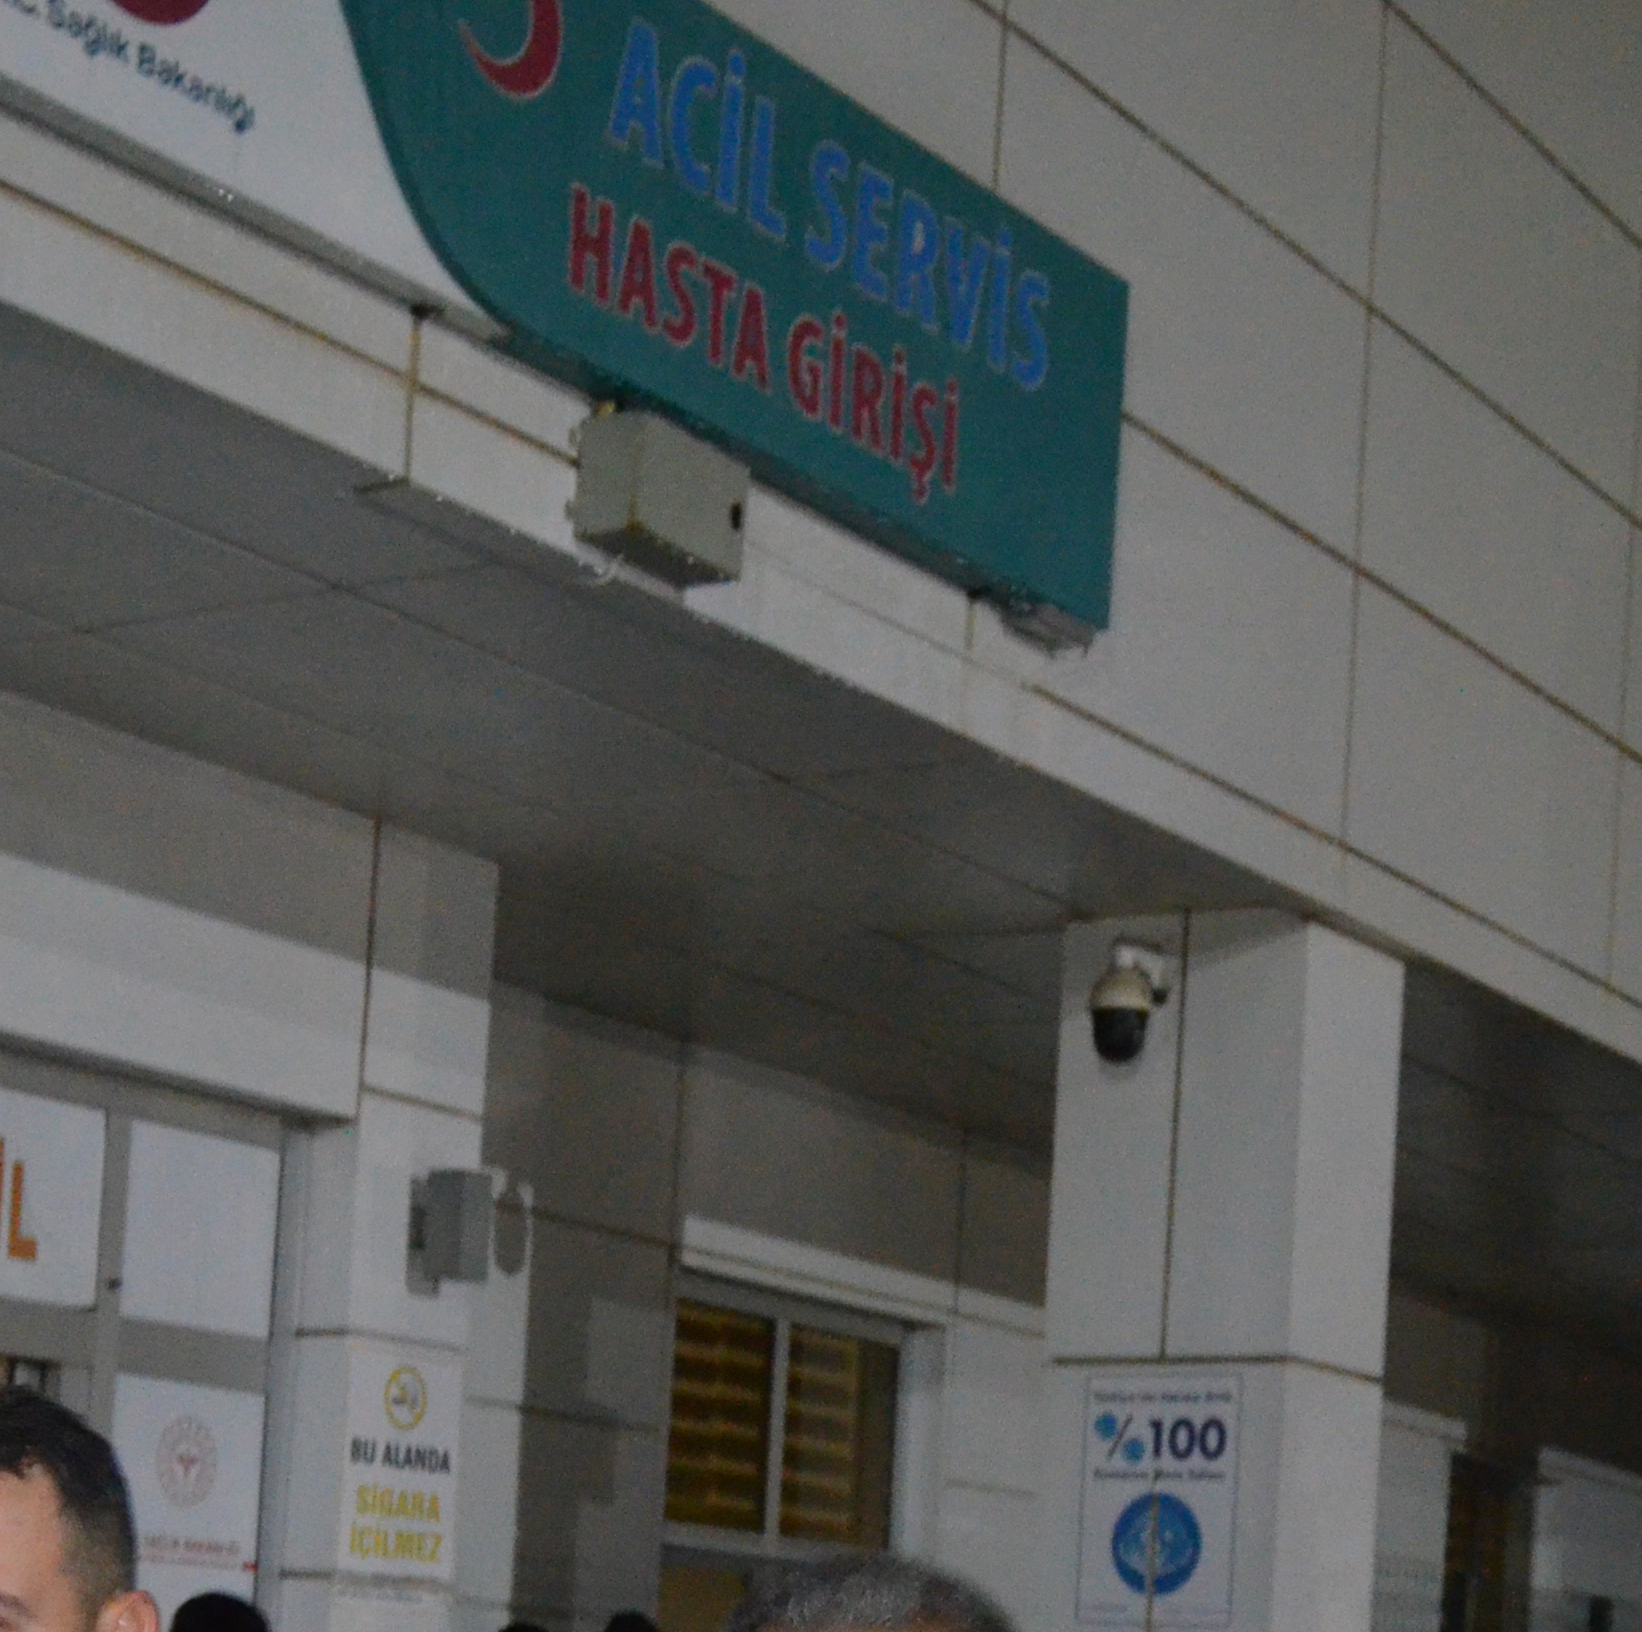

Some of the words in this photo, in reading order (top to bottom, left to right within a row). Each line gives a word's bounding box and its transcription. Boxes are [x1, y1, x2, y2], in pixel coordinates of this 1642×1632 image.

[567, 184, 772, 397] HASTA
[787, 309, 959, 505] GİRİŞİ
[609, 20, 787, 242] ACİL
[803, 138, 1049, 392] SERVİS
[350, 1436, 376, 1465] BU
[381, 1440, 451, 1475] ALANDA
